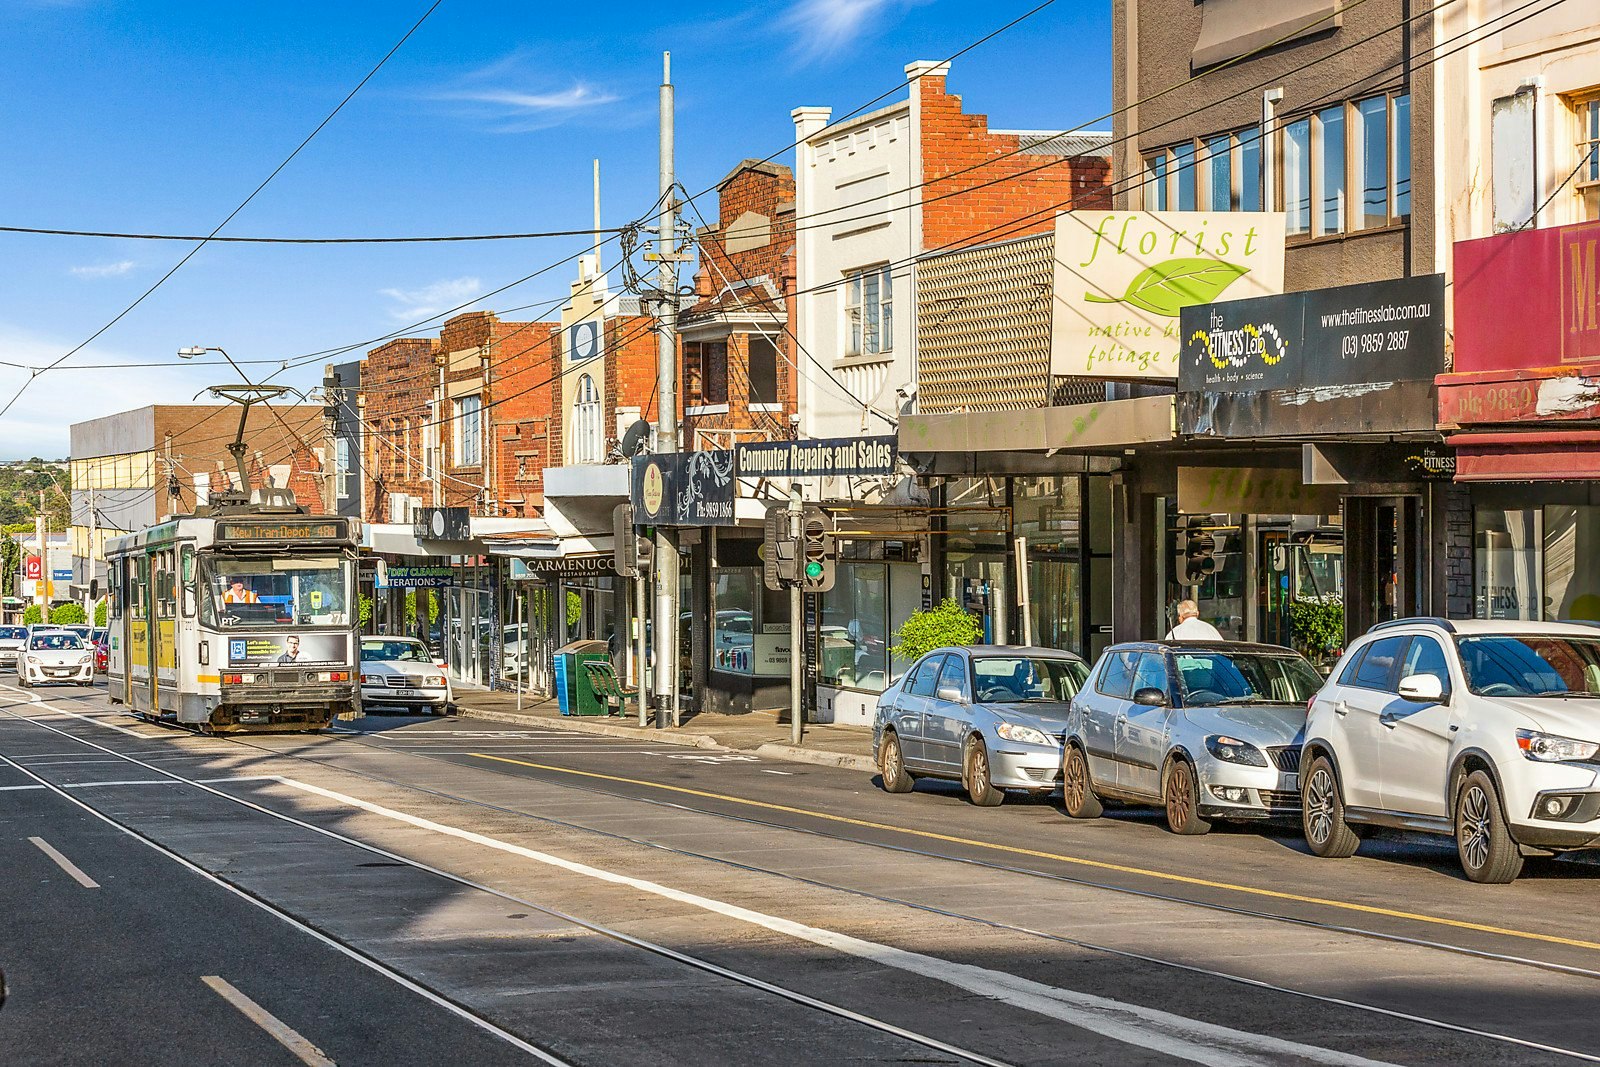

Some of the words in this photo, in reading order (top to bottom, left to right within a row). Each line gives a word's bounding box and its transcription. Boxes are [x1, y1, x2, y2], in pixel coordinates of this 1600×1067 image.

[1079, 215, 1258, 267] florist
[1570, 239, 1600, 333] M
[1210, 308, 1223, 328] the
[1321, 303, 1430, 327] www.thefitnesslab.com.au
[1088, 320, 1151, 337] native
[1209, 330, 1244, 358] FITNESS
[1246, 334, 1265, 356] Lab
[1341, 337, 1358, 359] (03)
[1361, 333, 1384, 353] 9859
[1387, 330, 1409, 351] 2887
[1086, 344, 1160, 371] foliage
[1206, 373, 1221, 384] health
[1227, 373, 1239, 382] body
[1245, 372, 1263, 381] science
[1487, 386, 1532, 411] 9859
[739, 446, 788, 473] Computer
[790, 443, 833, 472] Repairs
[834, 441, 857, 468] and
[858, 440, 891, 469] Sales
[1424, 447, 1436, 456] the
[1424, 457, 1455, 468] FITNESS
[254, 527, 278, 538] Tram
[280, 525, 310, 538] Depot
[410, 567, 454, 577] CLEANING
[526, 558, 616, 571] CARMENUCC
[389, 578, 435, 587] TERATIONS
